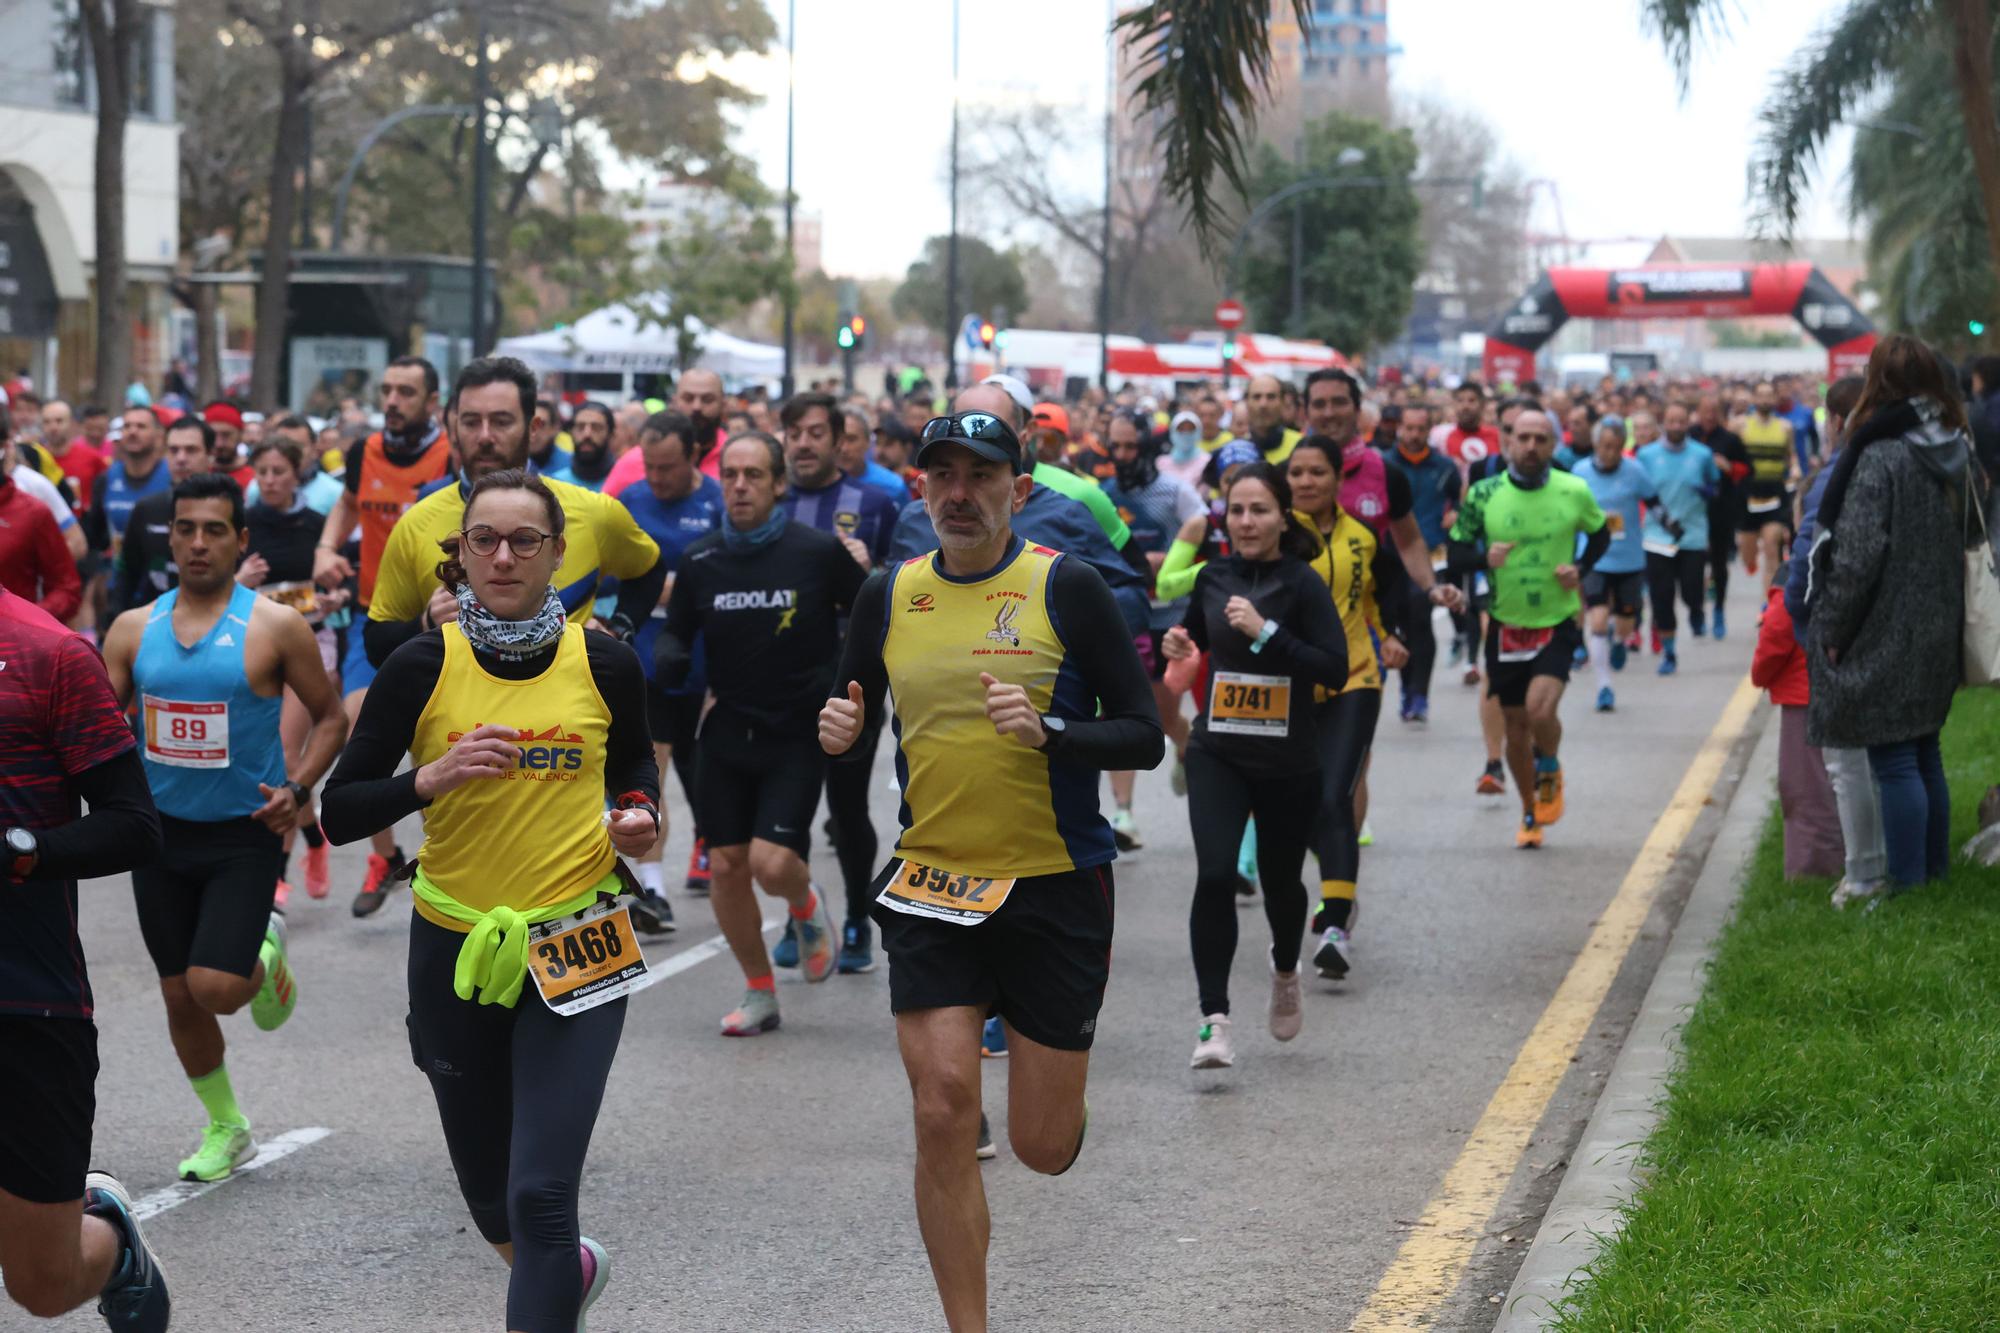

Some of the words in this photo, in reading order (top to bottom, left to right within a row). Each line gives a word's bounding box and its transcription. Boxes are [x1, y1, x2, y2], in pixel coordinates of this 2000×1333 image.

[997, 591, 1028, 601] COYOTE
[1223, 685, 1271, 712] 3741
[171, 717, 207, 741] 89
[908, 864, 993, 902] 3932
[537, 919, 623, 980] 3468
